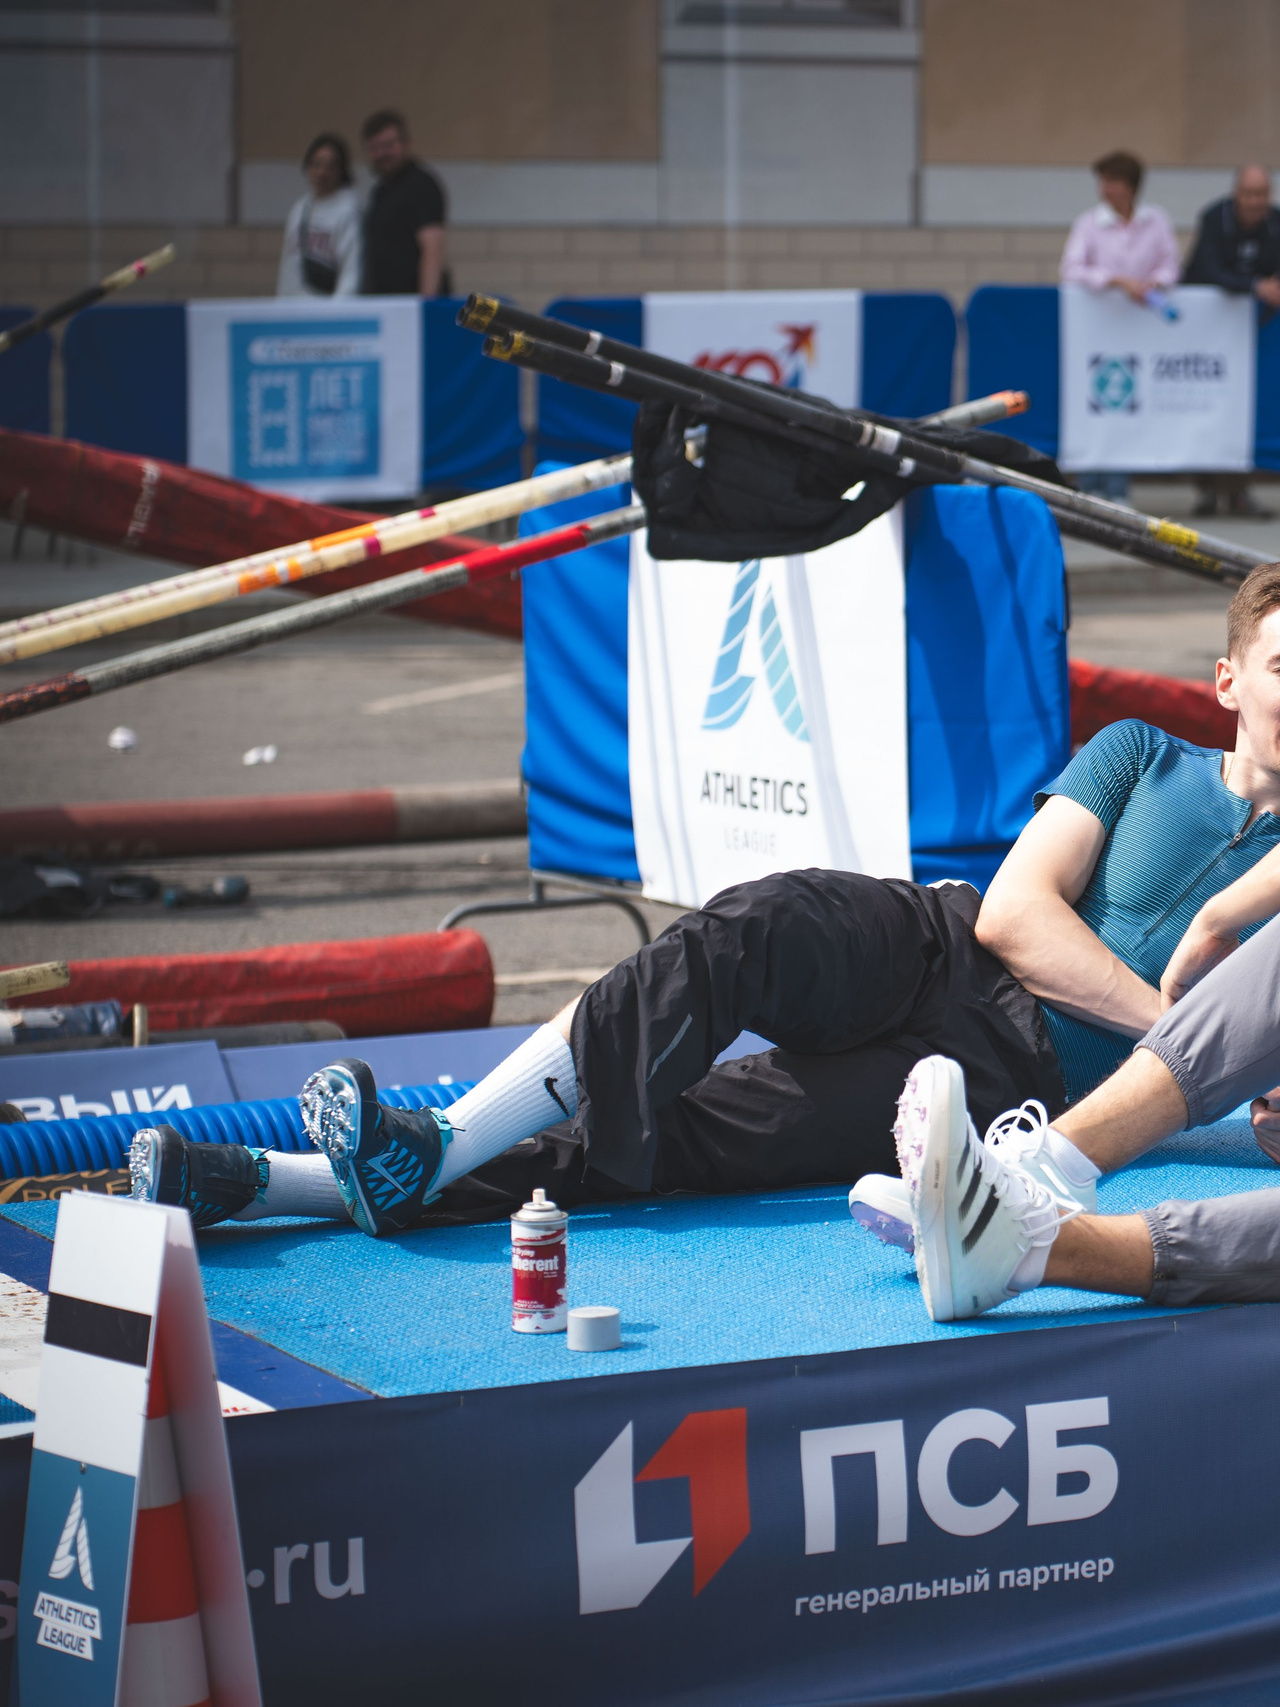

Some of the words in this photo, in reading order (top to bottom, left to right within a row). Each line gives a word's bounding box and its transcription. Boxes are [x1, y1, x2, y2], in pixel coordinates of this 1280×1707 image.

[700, 769, 808, 817] ATHLETICS
[723, 825, 778, 857] LEAGUE
[800, 1396, 1119, 1555] ПСБ
[794, 1567, 990, 1616] генеральный
[999, 1556, 1115, 1591] партнер
[37, 1598, 97, 1631] ATHLETICS
[43, 1625, 87, 1653] LEAGUE
